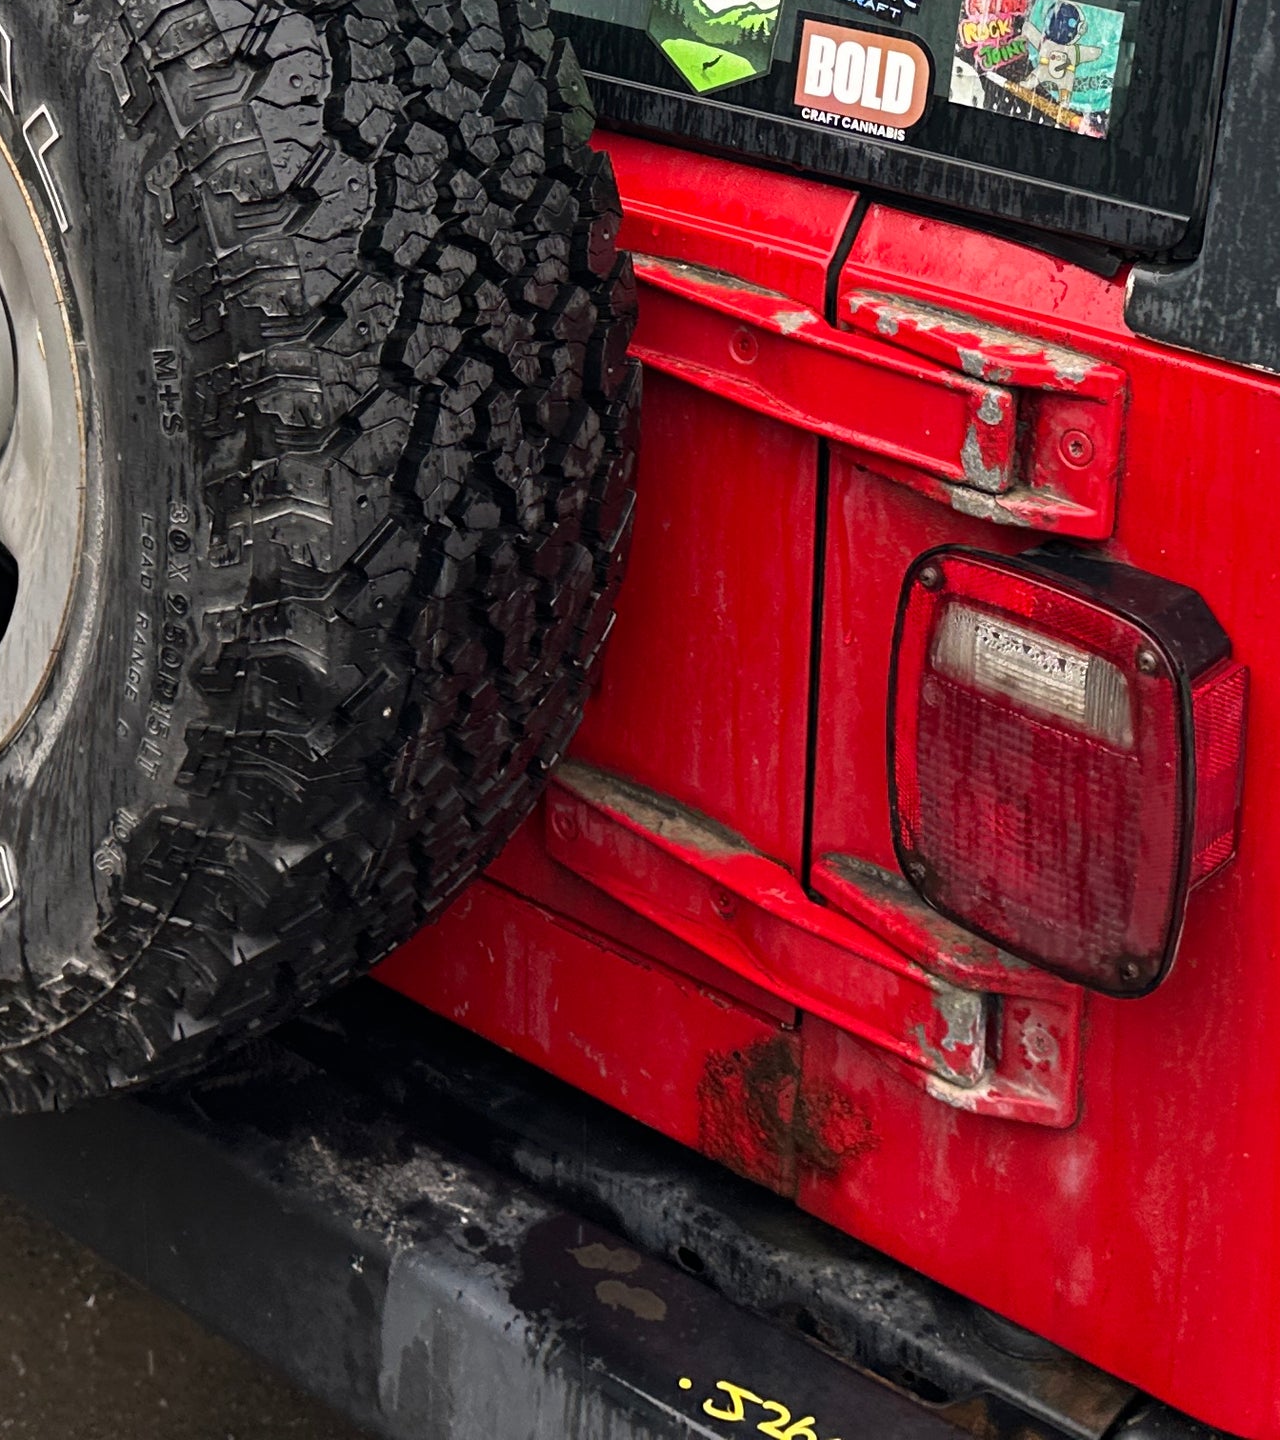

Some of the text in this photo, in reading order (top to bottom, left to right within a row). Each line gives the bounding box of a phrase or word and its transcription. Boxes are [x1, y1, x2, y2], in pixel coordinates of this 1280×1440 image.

[803, 33, 917, 116] BOLD
[801, 106, 906, 142] CRAFT CANNABIS
[151, 348, 185, 437] M+S
[139, 512, 157, 591] LOAD
[124, 611, 150, 703] RANGE
